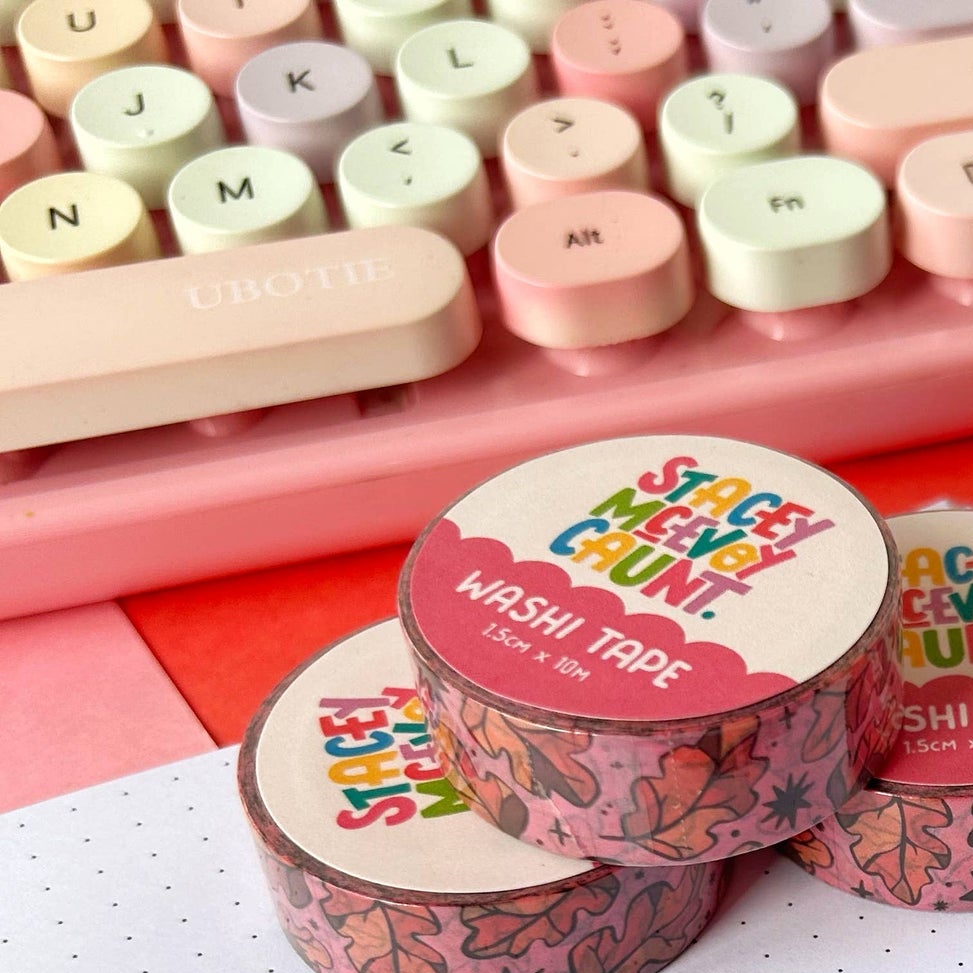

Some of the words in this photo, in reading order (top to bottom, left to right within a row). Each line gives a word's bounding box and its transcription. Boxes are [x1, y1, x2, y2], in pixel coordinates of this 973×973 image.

[66, 10, 97, 32] U
[448, 46, 474, 70] L
[286, 68, 314, 94] K
[123, 91, 146, 117] J
[216, 176, 256, 204] M
[47, 204, 81, 230] N
[768, 194, 806, 214] Fn
[564, 228, 604, 250] Alt
[185, 257, 396, 310] UBOTIE
[637, 456, 835, 550] STACEY
[549, 518, 753, 620] CAUNT.
[455, 570, 585, 639] WASHI
[587, 627, 693, 690] TAPE
[901, 703, 969, 733] SHI
[319, 697, 417, 830] STACEY
